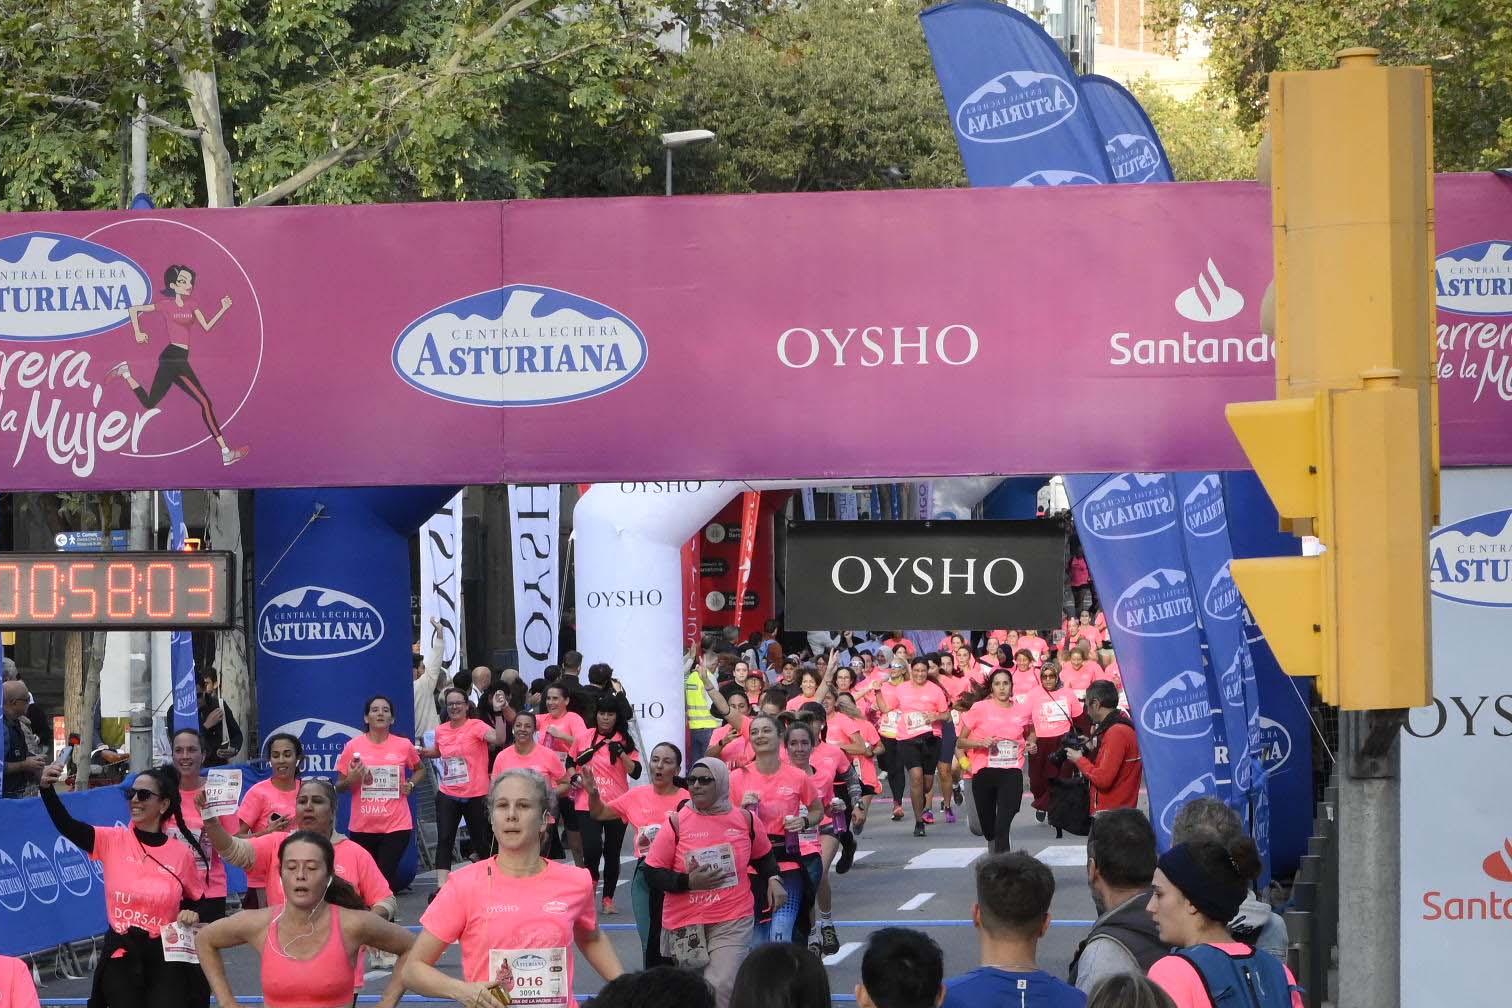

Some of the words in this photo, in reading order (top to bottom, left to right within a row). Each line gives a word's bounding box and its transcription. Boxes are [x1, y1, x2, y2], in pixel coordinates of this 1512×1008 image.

[55, 268, 127, 280] LECHERA
[1436, 269, 1512, 297] STUR
[451, 328, 532, 341] CENTRAL
[538, 325, 619, 338] LECHERA
[776, 324, 979, 369] OYSHO
[412, 332, 628, 377] ASTURIANA
[1110, 332, 1276, 366] Santand
[1460, 352, 1479, 378] la
[13, 384, 162, 479] Mujer
[831, 555, 1025, 597] OYSHO
[1430, 547, 1512, 583] ASTU
[587, 590, 662, 609] OYSHO
[261, 616, 375, 643] ASTURIANA
[115, 891, 131, 905] TU
[114, 907, 163, 927] DORSAL
[516, 976, 543, 987] 016
